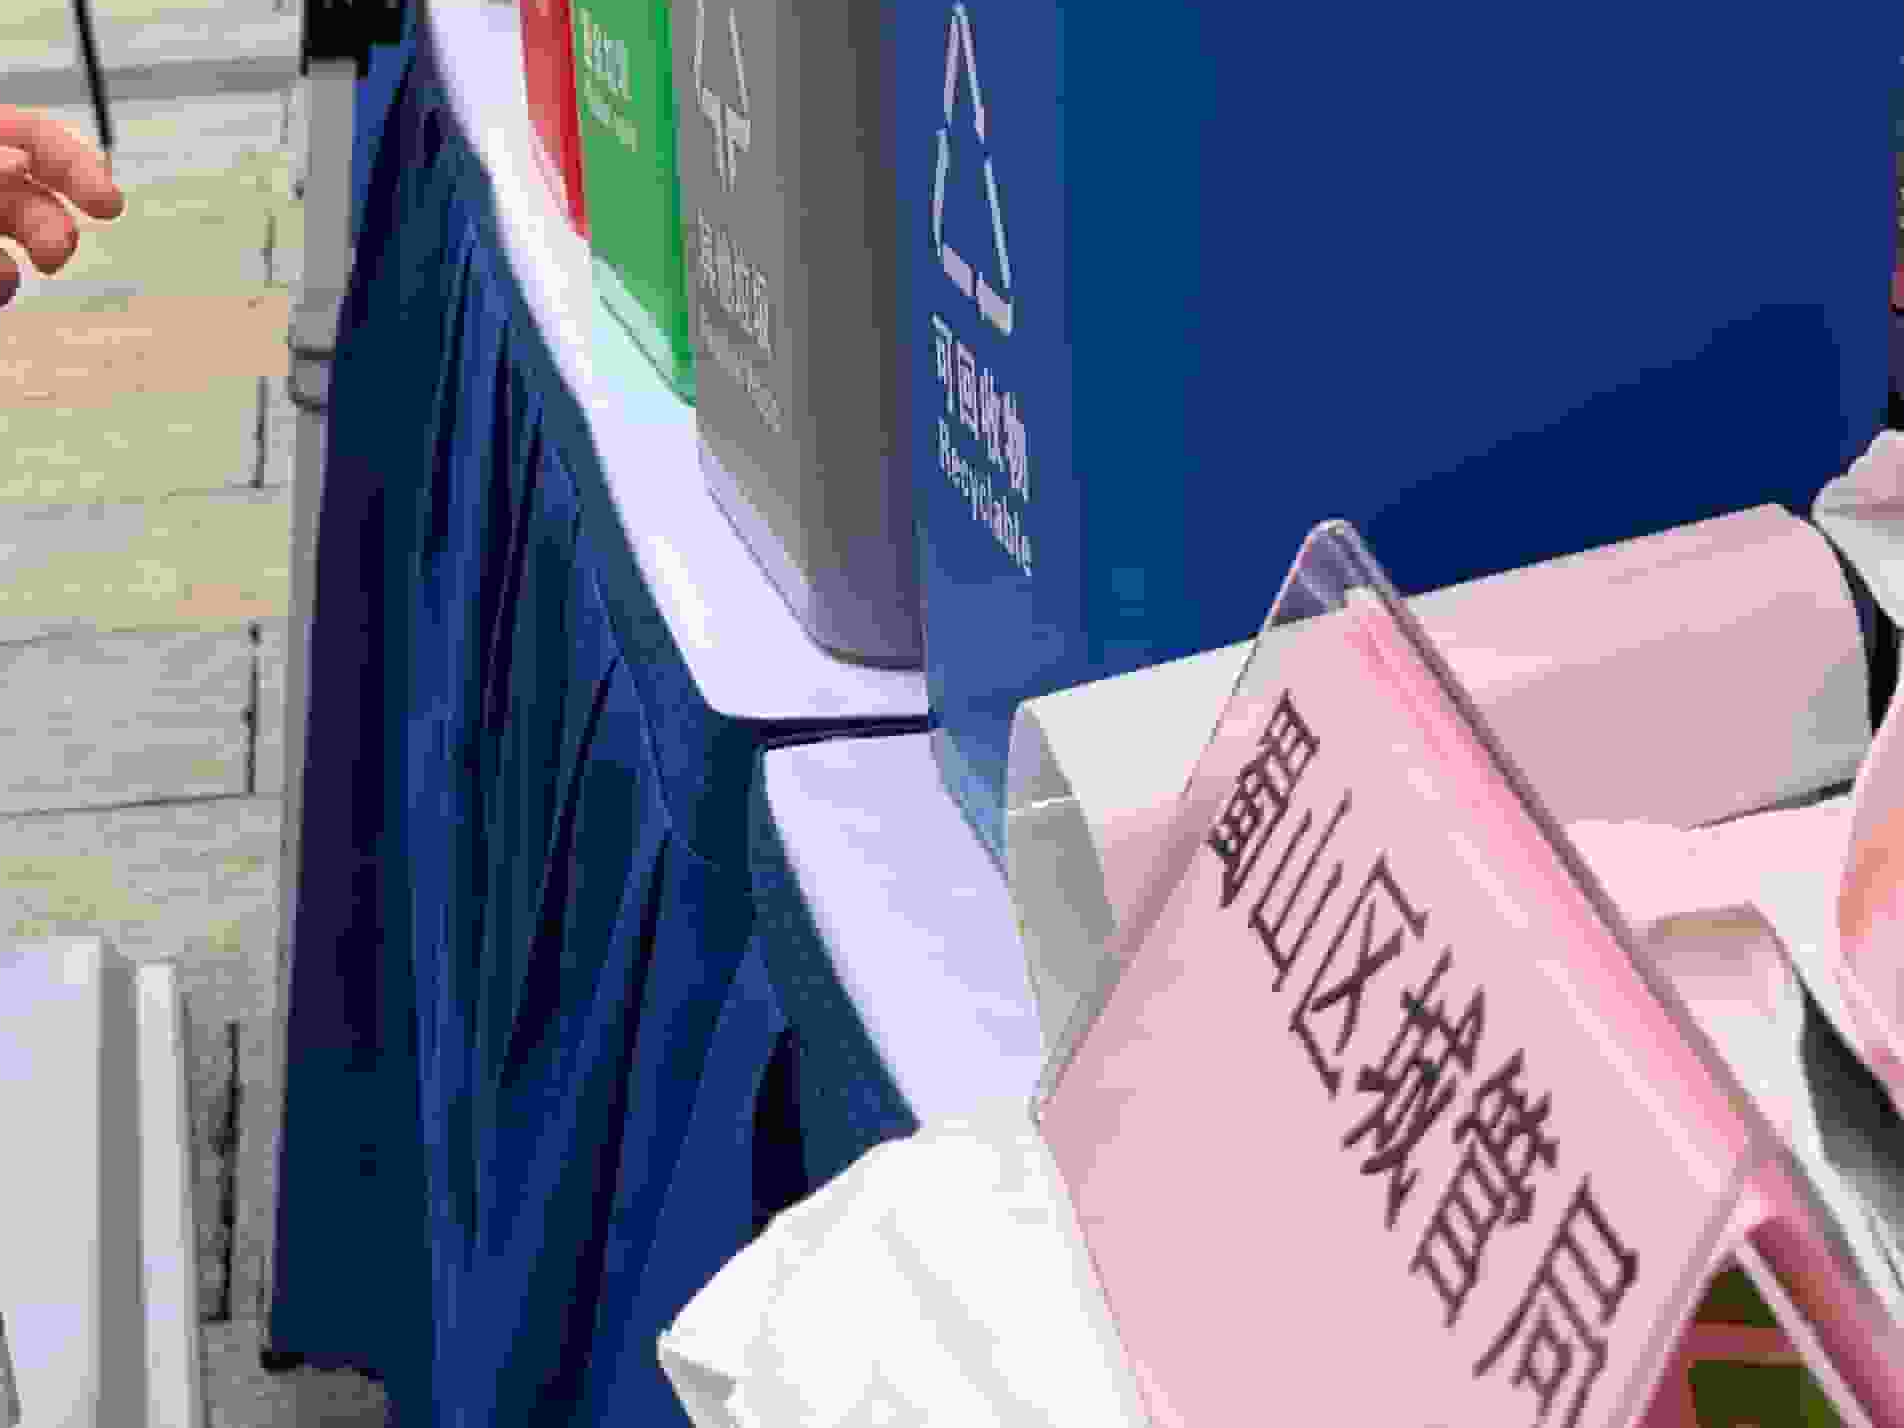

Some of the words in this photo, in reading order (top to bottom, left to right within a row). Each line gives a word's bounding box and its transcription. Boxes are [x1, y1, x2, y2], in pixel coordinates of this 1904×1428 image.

[930, 311, 1030, 503] 可回收物
[936, 416, 1032, 576] Recyclable
[1207, 688, 1639, 1428] 蜀山区城管局
